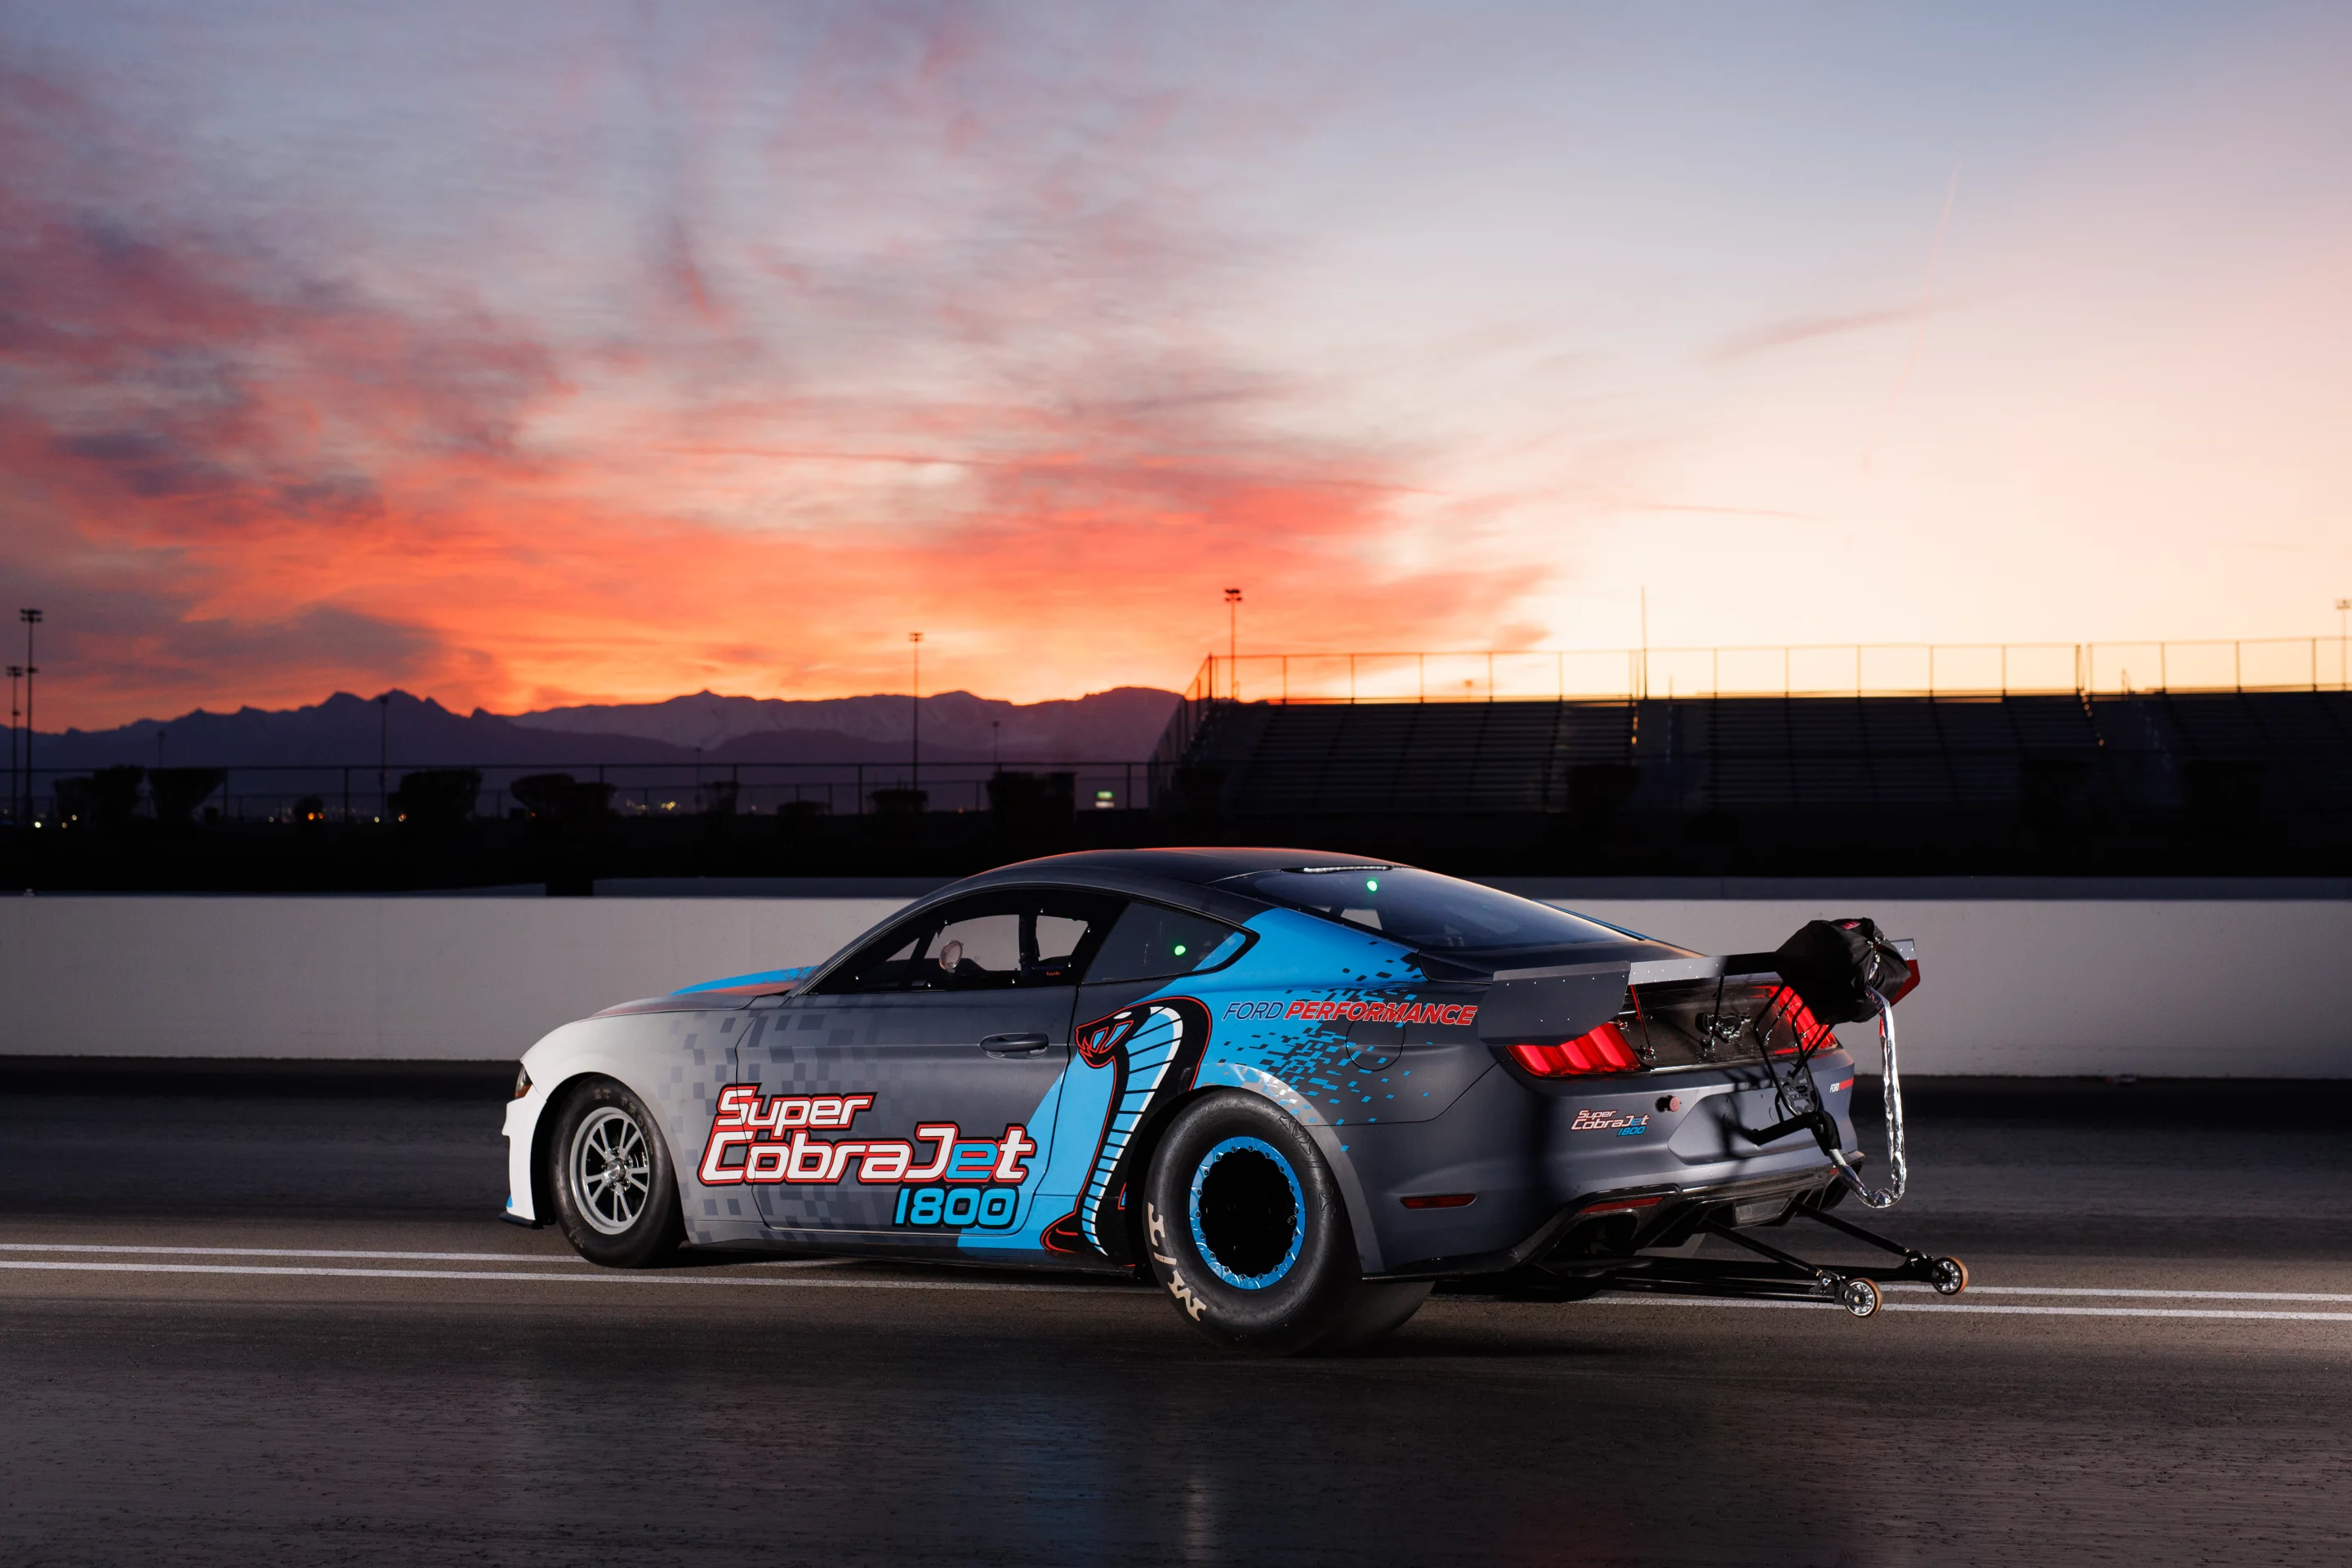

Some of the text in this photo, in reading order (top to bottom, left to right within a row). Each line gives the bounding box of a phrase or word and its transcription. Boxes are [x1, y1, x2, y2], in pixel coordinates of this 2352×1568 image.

[1223, 1001, 1478, 1026] FORD PERFORMANCE
[715, 1087, 871, 1138] Super
[1570, 1114, 1650, 1130] CobraJet
[1576, 1109, 1617, 1120] Super
[1617, 1126, 1646, 1136] 1800
[700, 1125, 1034, 1182] CobraJet
[895, 1187, 1018, 1226] 1800
